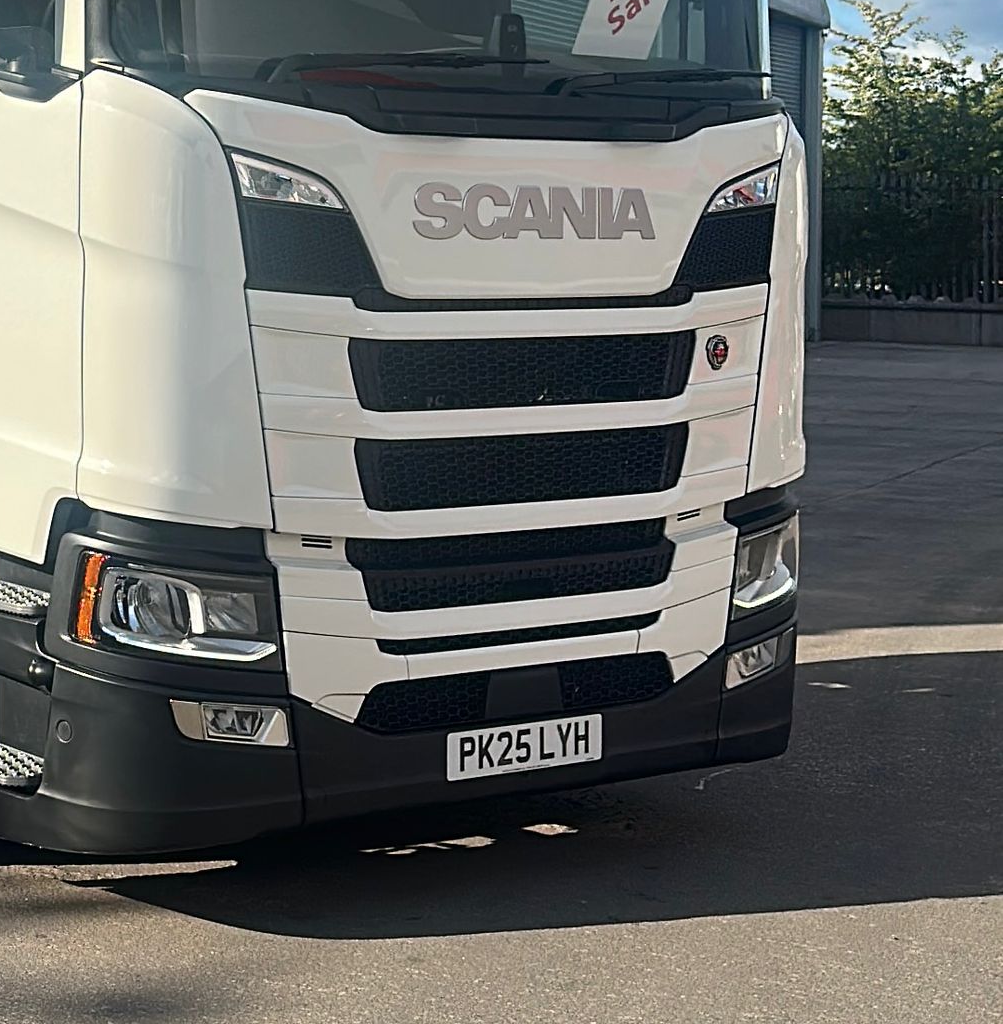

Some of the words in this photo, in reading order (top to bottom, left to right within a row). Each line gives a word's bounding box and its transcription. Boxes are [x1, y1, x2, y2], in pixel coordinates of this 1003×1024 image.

[412, 181, 656, 240] SCANIA
[459, 728, 531, 772] PK25
[539, 720, 590, 761] LYH
